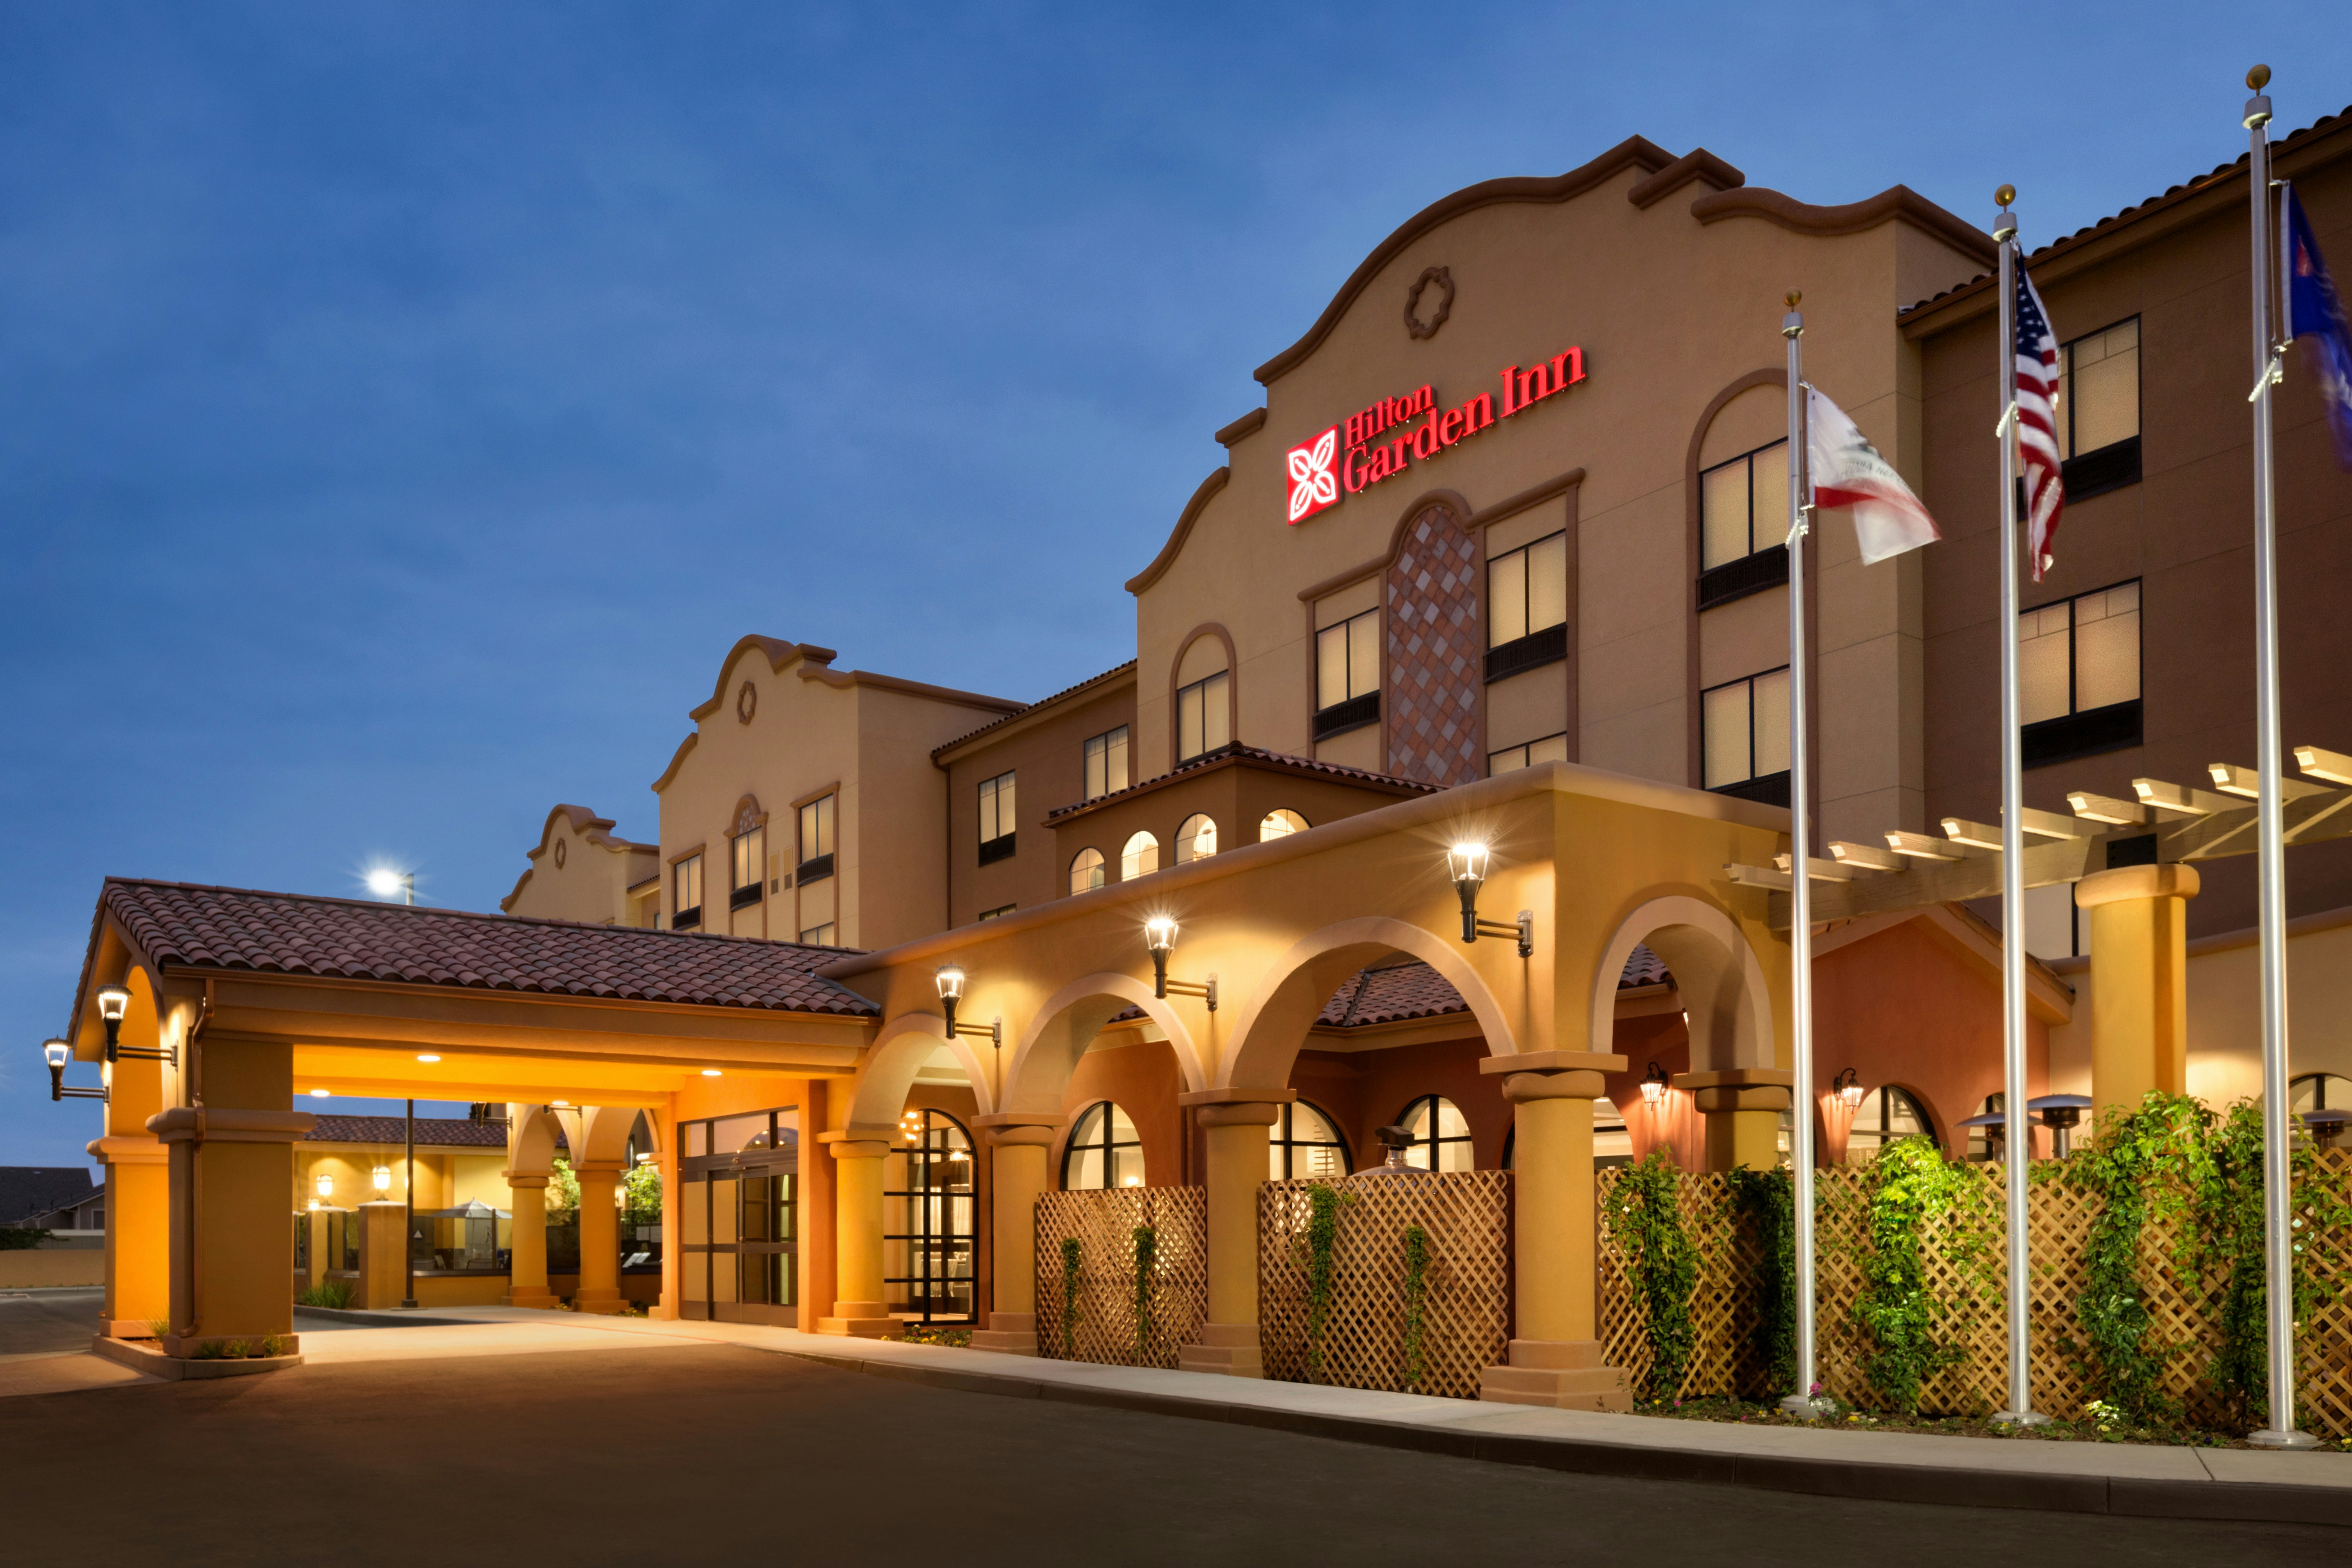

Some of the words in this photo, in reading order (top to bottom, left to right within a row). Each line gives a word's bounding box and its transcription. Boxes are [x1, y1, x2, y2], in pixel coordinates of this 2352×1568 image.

[1343, 392, 1494, 493] Garden
[1499, 346, 1586, 418] Inn
[1344, 384, 1434, 450] Hilton
